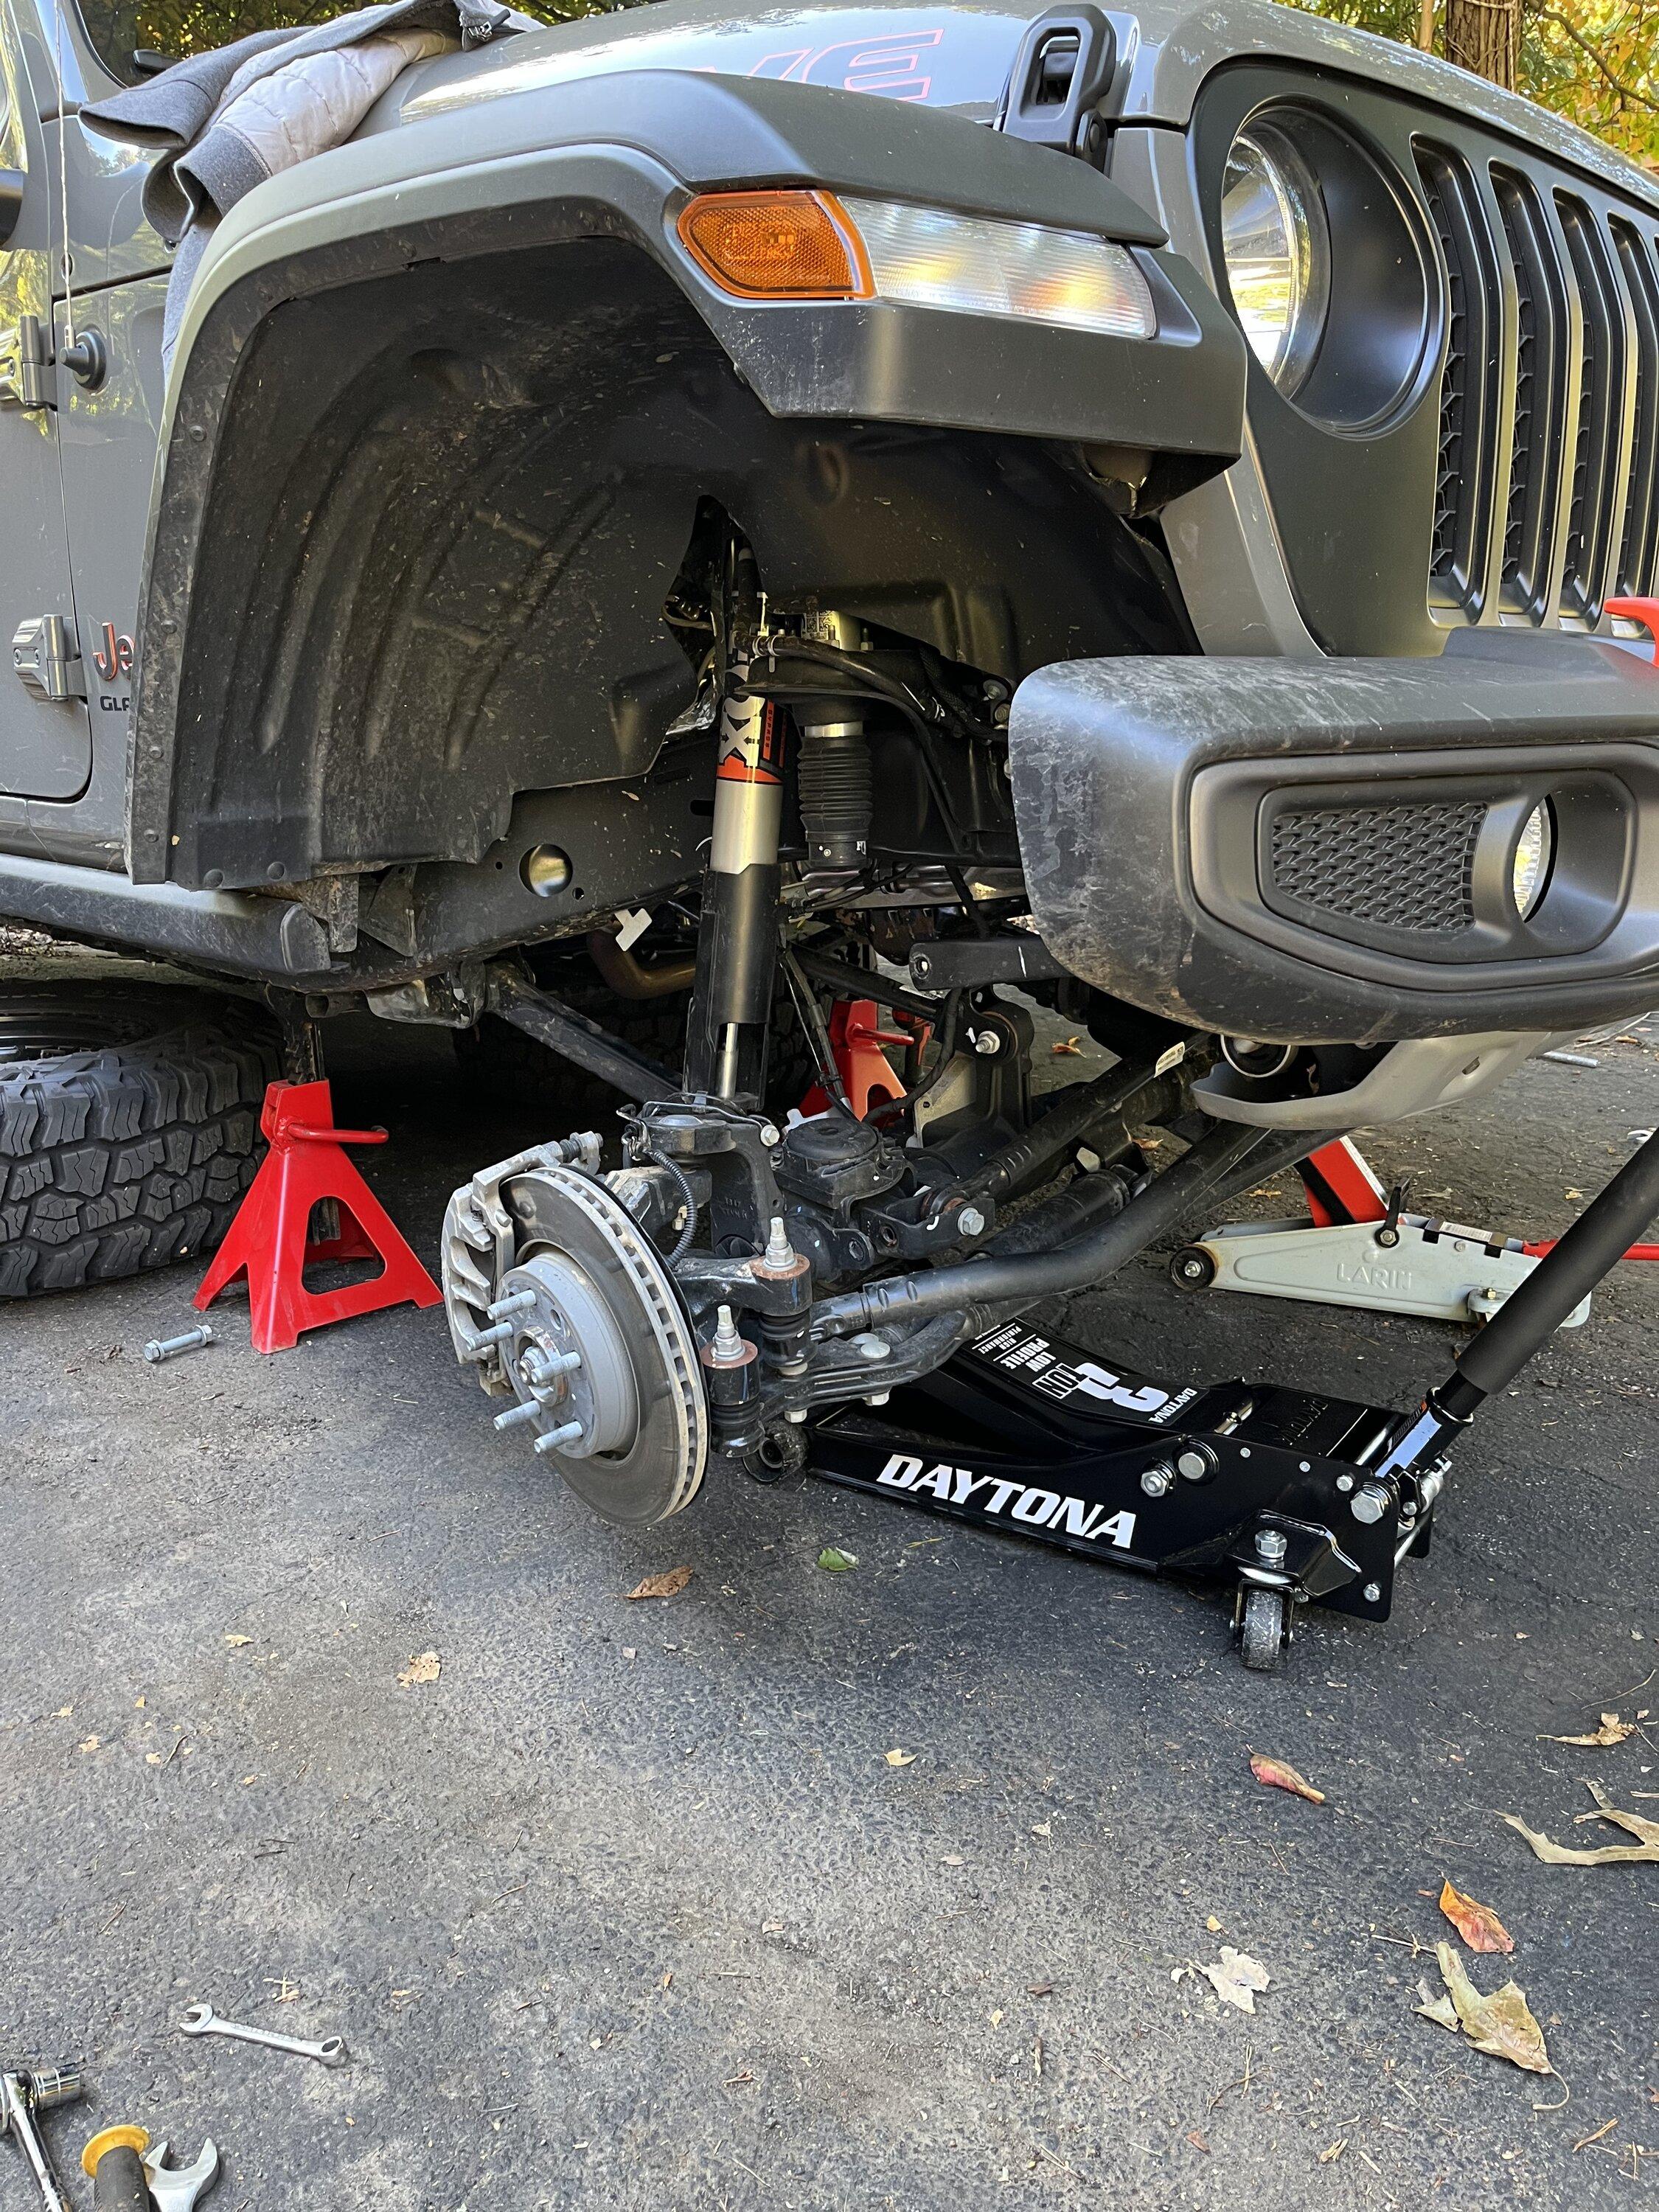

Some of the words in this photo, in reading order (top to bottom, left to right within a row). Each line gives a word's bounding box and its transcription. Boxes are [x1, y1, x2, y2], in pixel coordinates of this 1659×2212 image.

[1336, 1262, 1413, 1290] LARIN
[978, 1325, 1023, 1354] PERFORMANCE
[1000, 1337, 1051, 1370] PROFILE
[1024, 1351, 1057, 1373] LOW
[1032, 1362, 1086, 1400] TON
[1074, 1362, 1170, 1413] 3
[1148, 1387, 1198, 1424] DAYTONA
[876, 1453, 1137, 1549] DAYTONA
